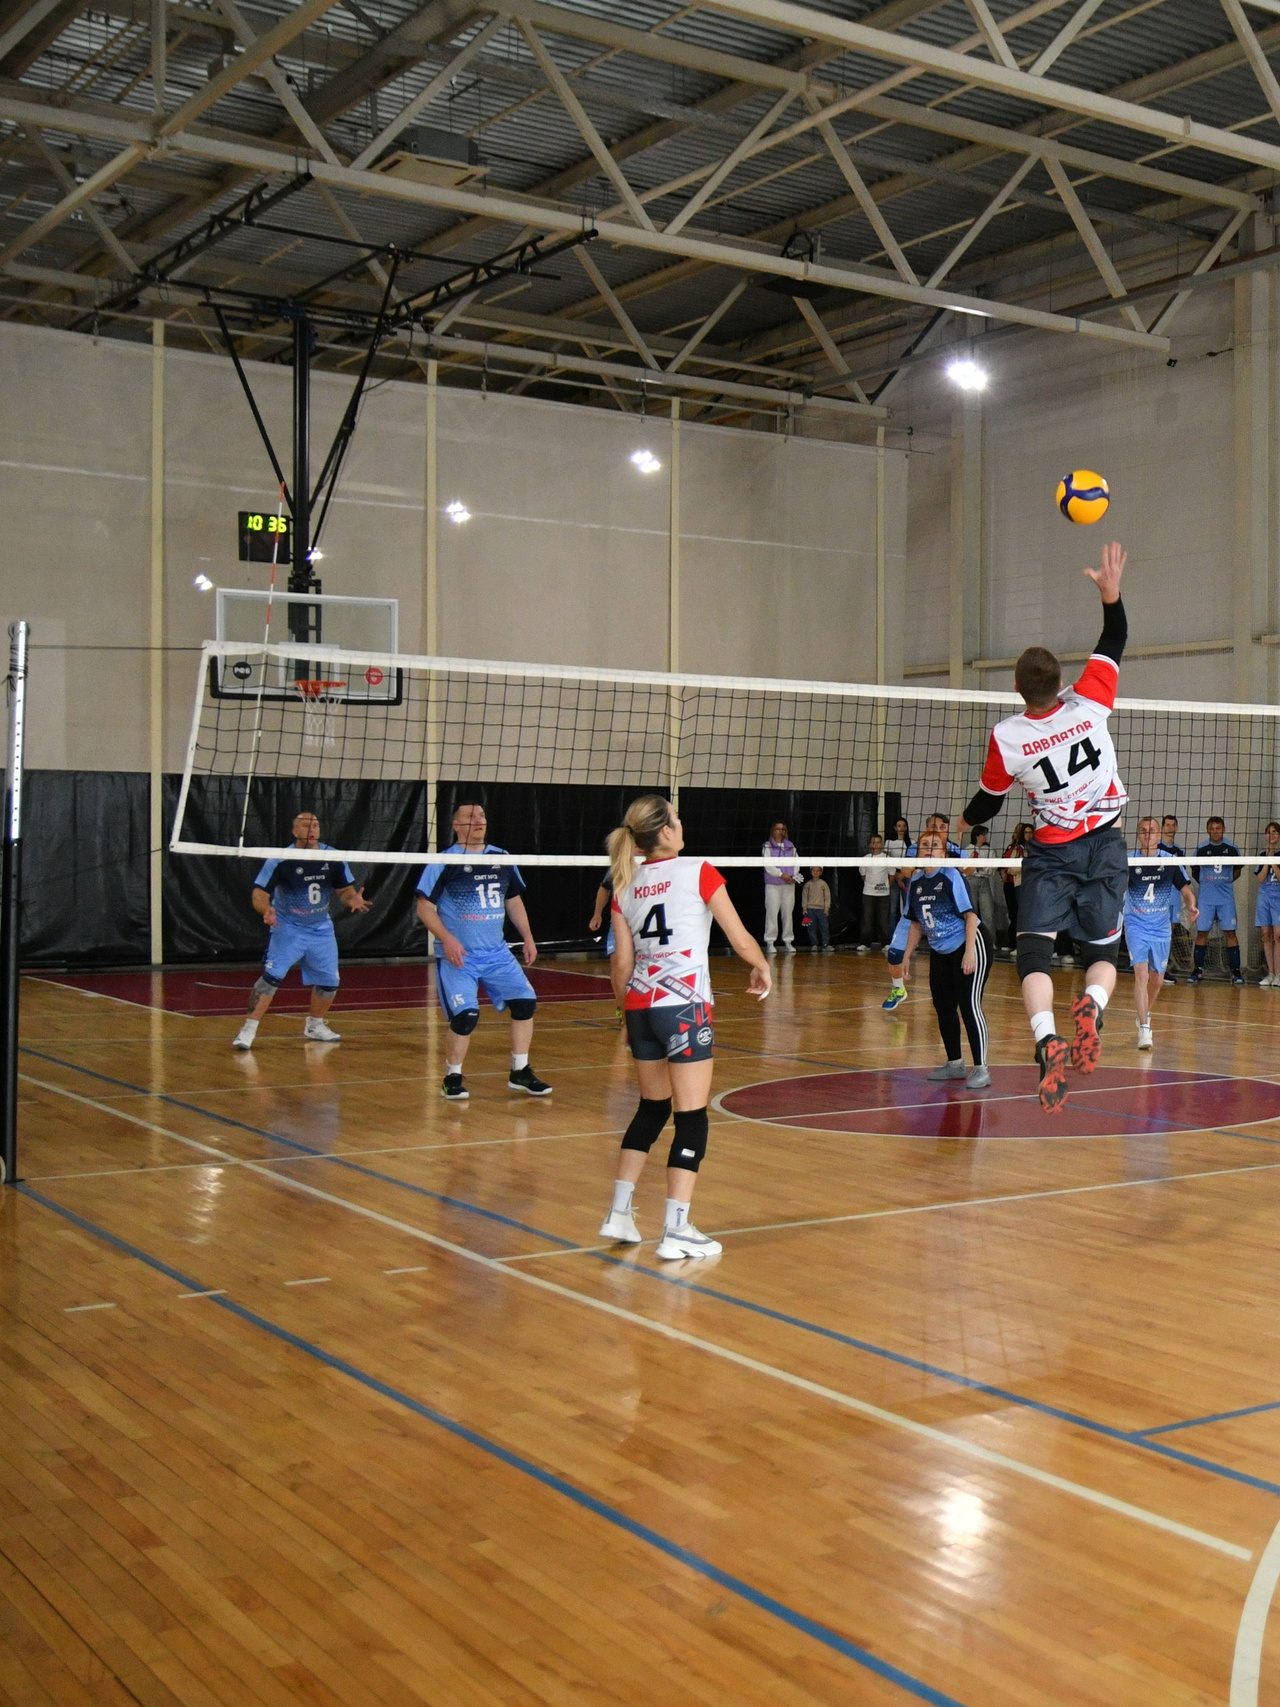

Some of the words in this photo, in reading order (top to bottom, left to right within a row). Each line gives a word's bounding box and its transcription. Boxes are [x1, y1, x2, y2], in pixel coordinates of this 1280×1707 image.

[1032, 736, 1102, 794] 14
[308, 882, 321, 905] 6
[475, 882, 501, 909] 15
[633, 881, 672, 899] КОЗАР
[1143, 883, 1156, 904] 4
[639, 903, 674, 946] 4
[921, 904, 935, 929] 5
